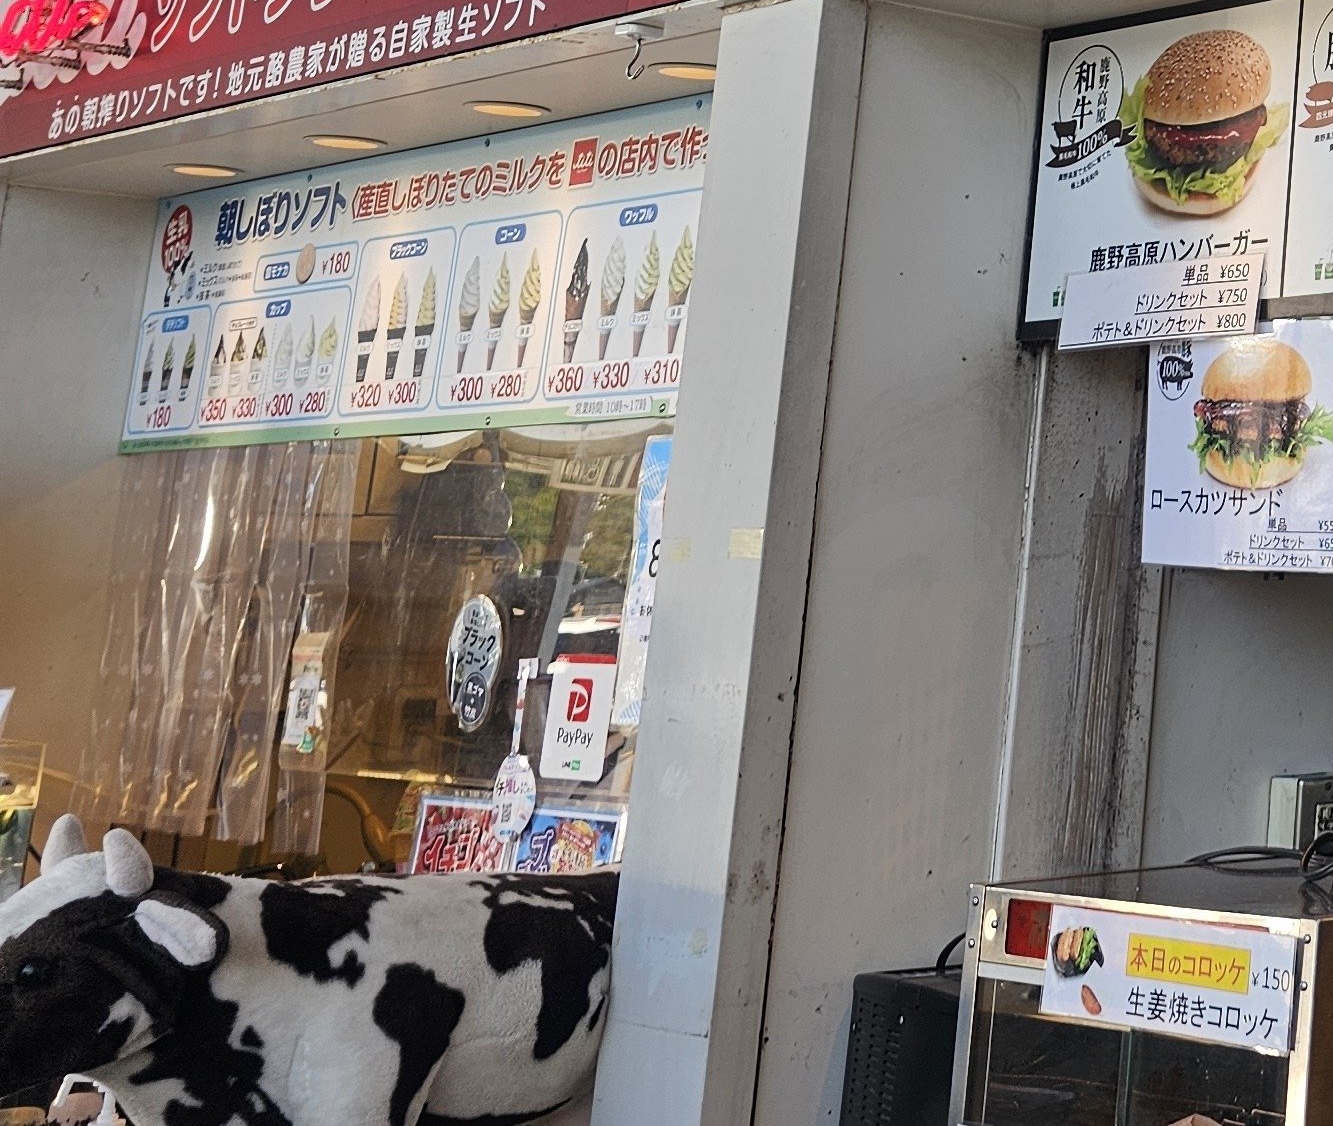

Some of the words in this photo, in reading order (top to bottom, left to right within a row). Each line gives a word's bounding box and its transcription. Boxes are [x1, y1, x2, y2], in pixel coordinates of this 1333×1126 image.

[1071, 59, 1097, 129] 和牛
[1077, 128, 1108, 160] 100%
[215, 180, 347, 247] 朝しぼりソフト
[624, 207, 654, 223] ワッフル
[500, 228, 522, 241] コーン
[322, 252, 351, 275] ¥180
[1088, 230, 1269, 273] 鹿野高原ハンバーガー
[1183, 264, 1209, 284] 単品
[1220, 262, 1250, 279] ¥650
[1135, 291, 1208, 312] ドリンクセット
[1218, 287, 1248, 304] ¥750
[1091, 317, 1207, 341] ポテト&ドリンクセット
[1217, 312, 1247, 329] ¥800
[450, 376, 484, 402] ¥300
[490, 374, 522, 399] ¥280
[548, 365, 584, 393] ¥360
[593, 361, 631, 389] ¥330
[644, 358, 680, 384] ¥310
[265, 393, 294, 417] ¥300
[300, 391, 326, 413] ¥280
[351, 384, 382, 409] ¥320
[388, 381, 417, 404] ¥300
[146, 405, 172, 428] ¥180
[201, 398, 227, 422] ¥350
[232, 397, 257, 419] ¥330
[1151, 487, 1283, 516] ロースカツサンド
[1267, 518, 1287, 531] 単品
[1250, 535, 1304, 549] ドリンクセット
[461, 625, 496, 652] ブラック
[465, 651, 489, 671] コーン
[557, 727, 594, 748] PayPay
[1130, 943, 1246, 986] 本日のコロッケ
[1252, 966, 1291, 992] ¥150
[1126, 986, 1279, 1039] 生姜焼きコロッケ
